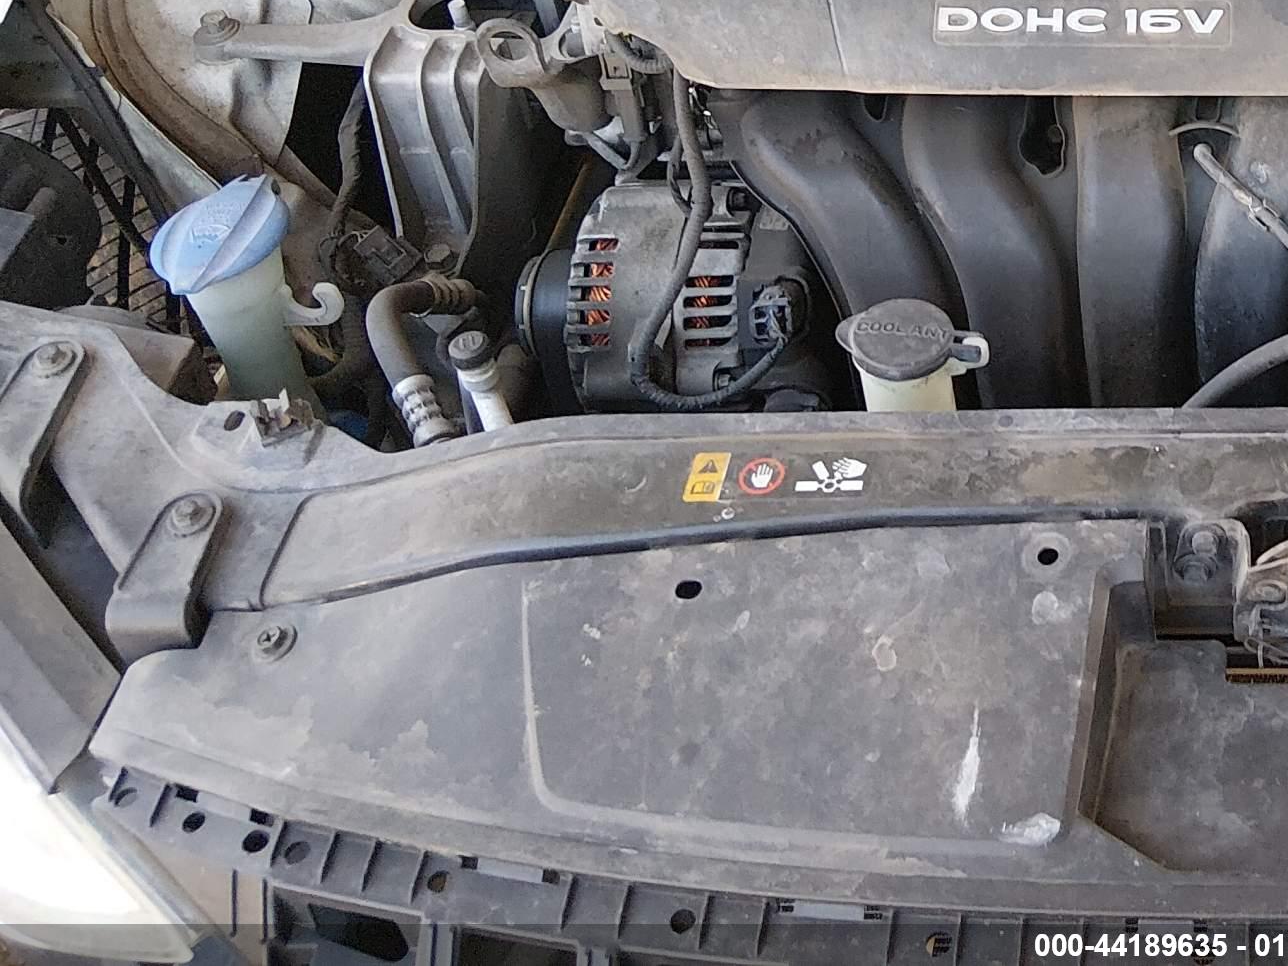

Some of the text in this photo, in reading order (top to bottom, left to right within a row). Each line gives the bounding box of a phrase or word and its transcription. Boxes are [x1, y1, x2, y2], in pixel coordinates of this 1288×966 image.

[937, 7, 1225, 35] DOHC 16V
[855, 321, 950, 341] COOLANT
